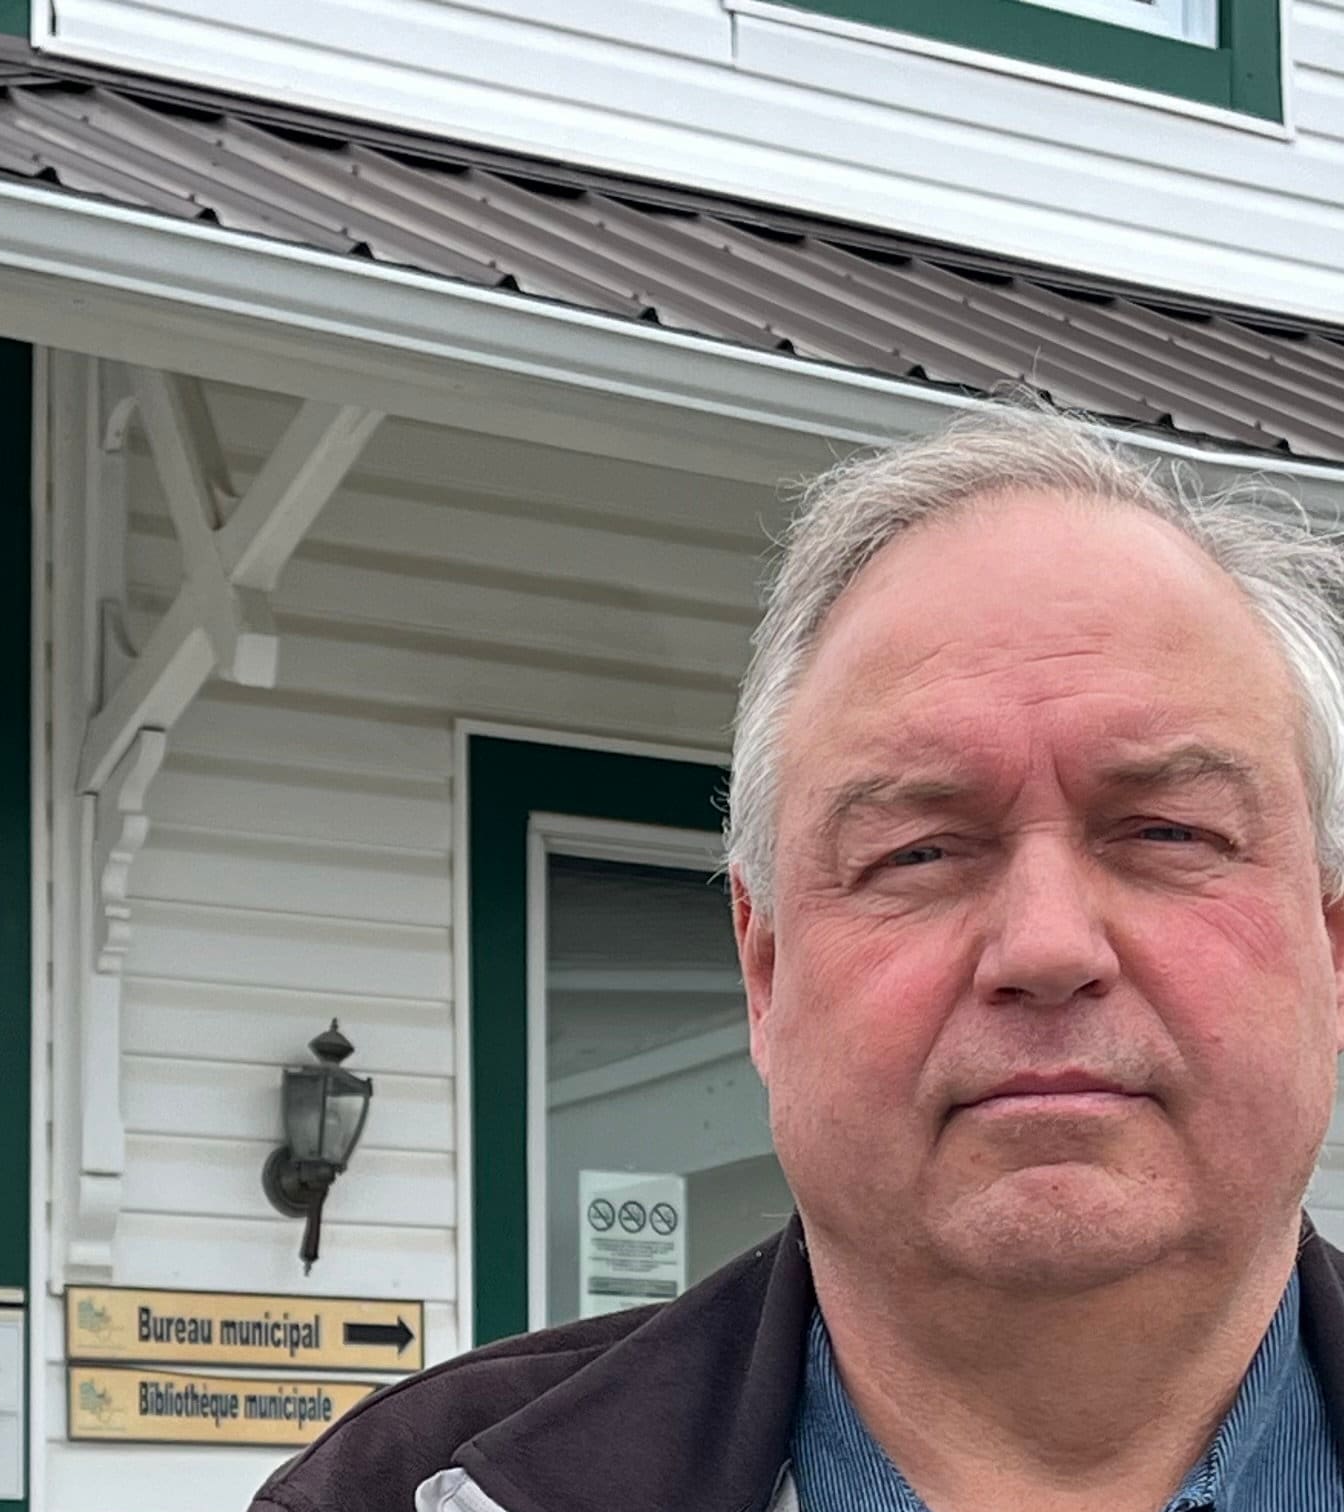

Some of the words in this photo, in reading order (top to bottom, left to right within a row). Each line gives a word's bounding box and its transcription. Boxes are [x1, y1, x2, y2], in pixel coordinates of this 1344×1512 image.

[138, 1306, 212, 1344] Bureau
[220, 1311, 320, 1357] municipal
[139, 1381, 239, 1428] Bibliothèque
[244, 1386, 332, 1430] municipale
